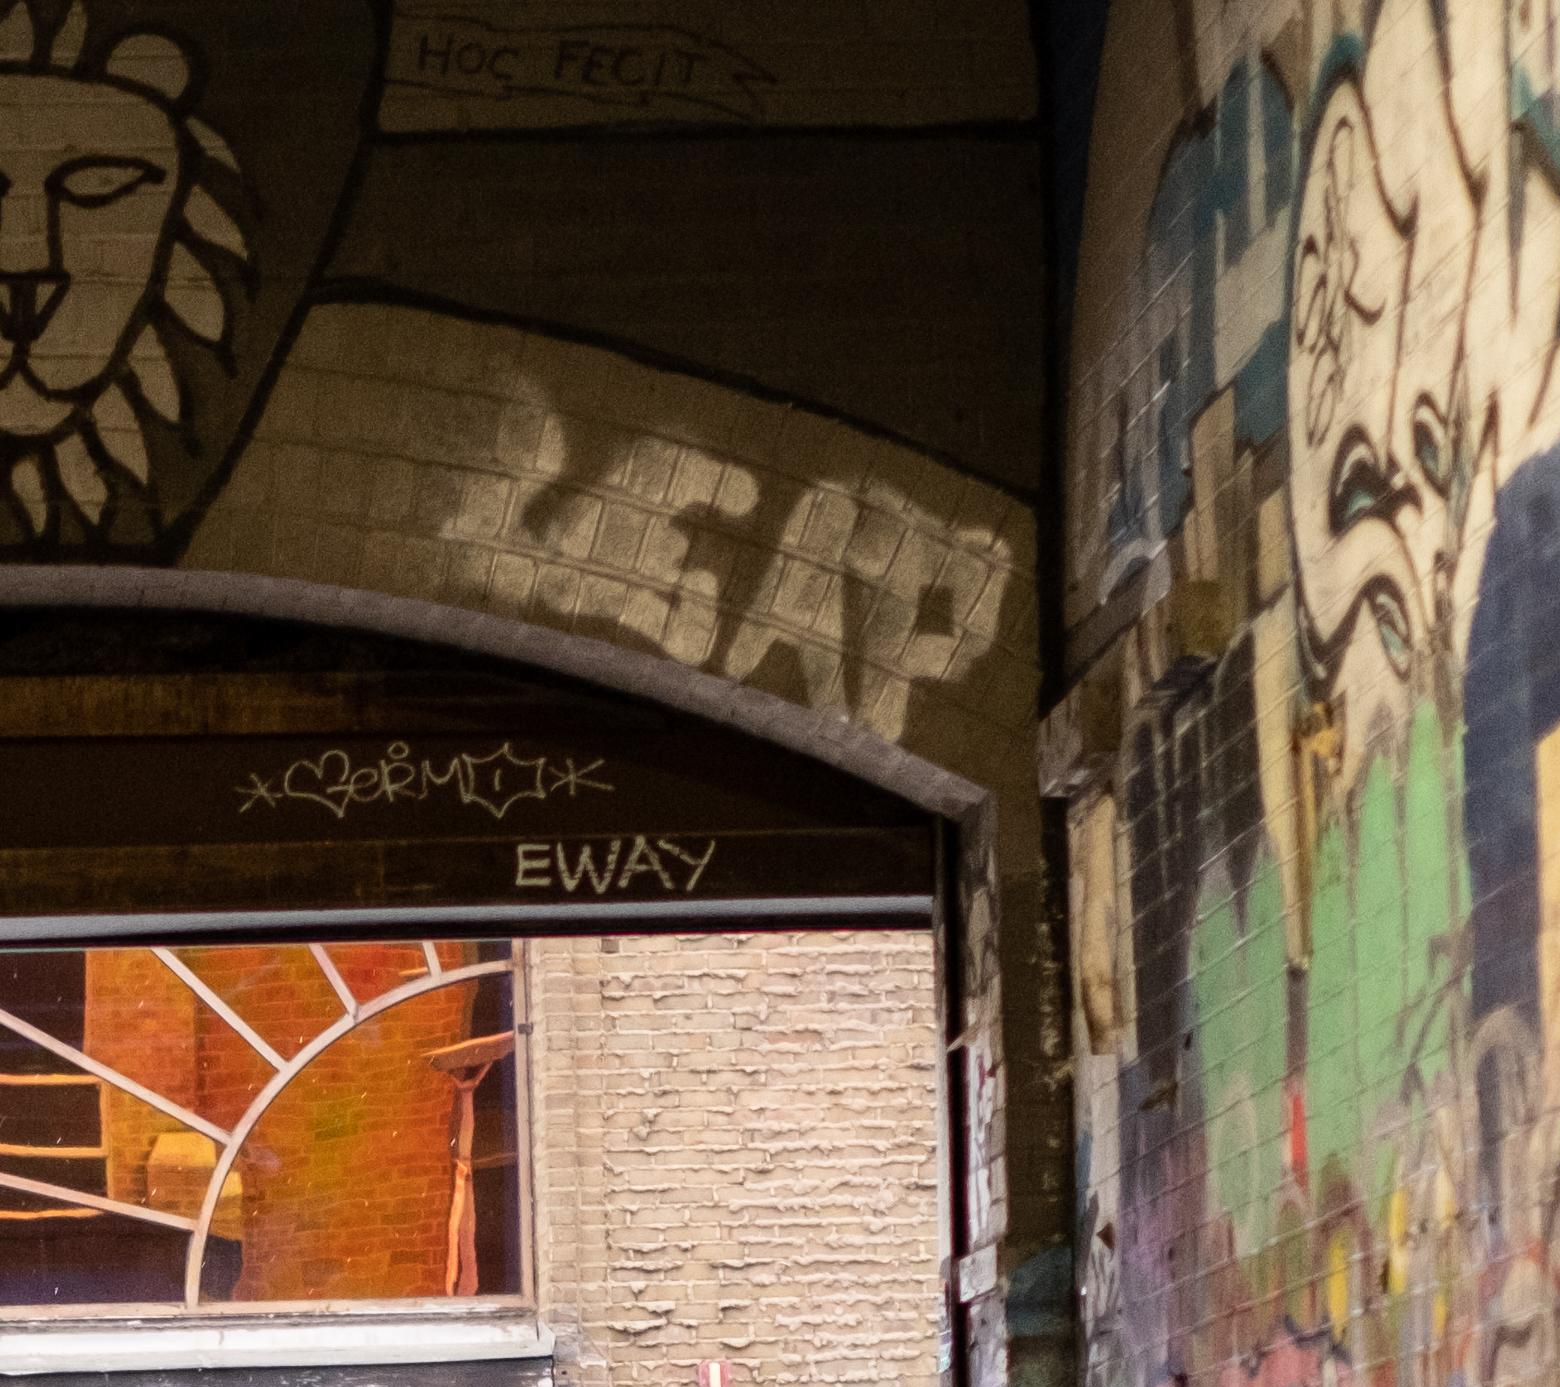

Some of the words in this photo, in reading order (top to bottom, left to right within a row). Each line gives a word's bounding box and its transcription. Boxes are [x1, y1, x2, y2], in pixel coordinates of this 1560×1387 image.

[416, 34, 511, 82] HOC
[552, 36, 706, 84] FECIT
[514, 837, 716, 894] EWAY
